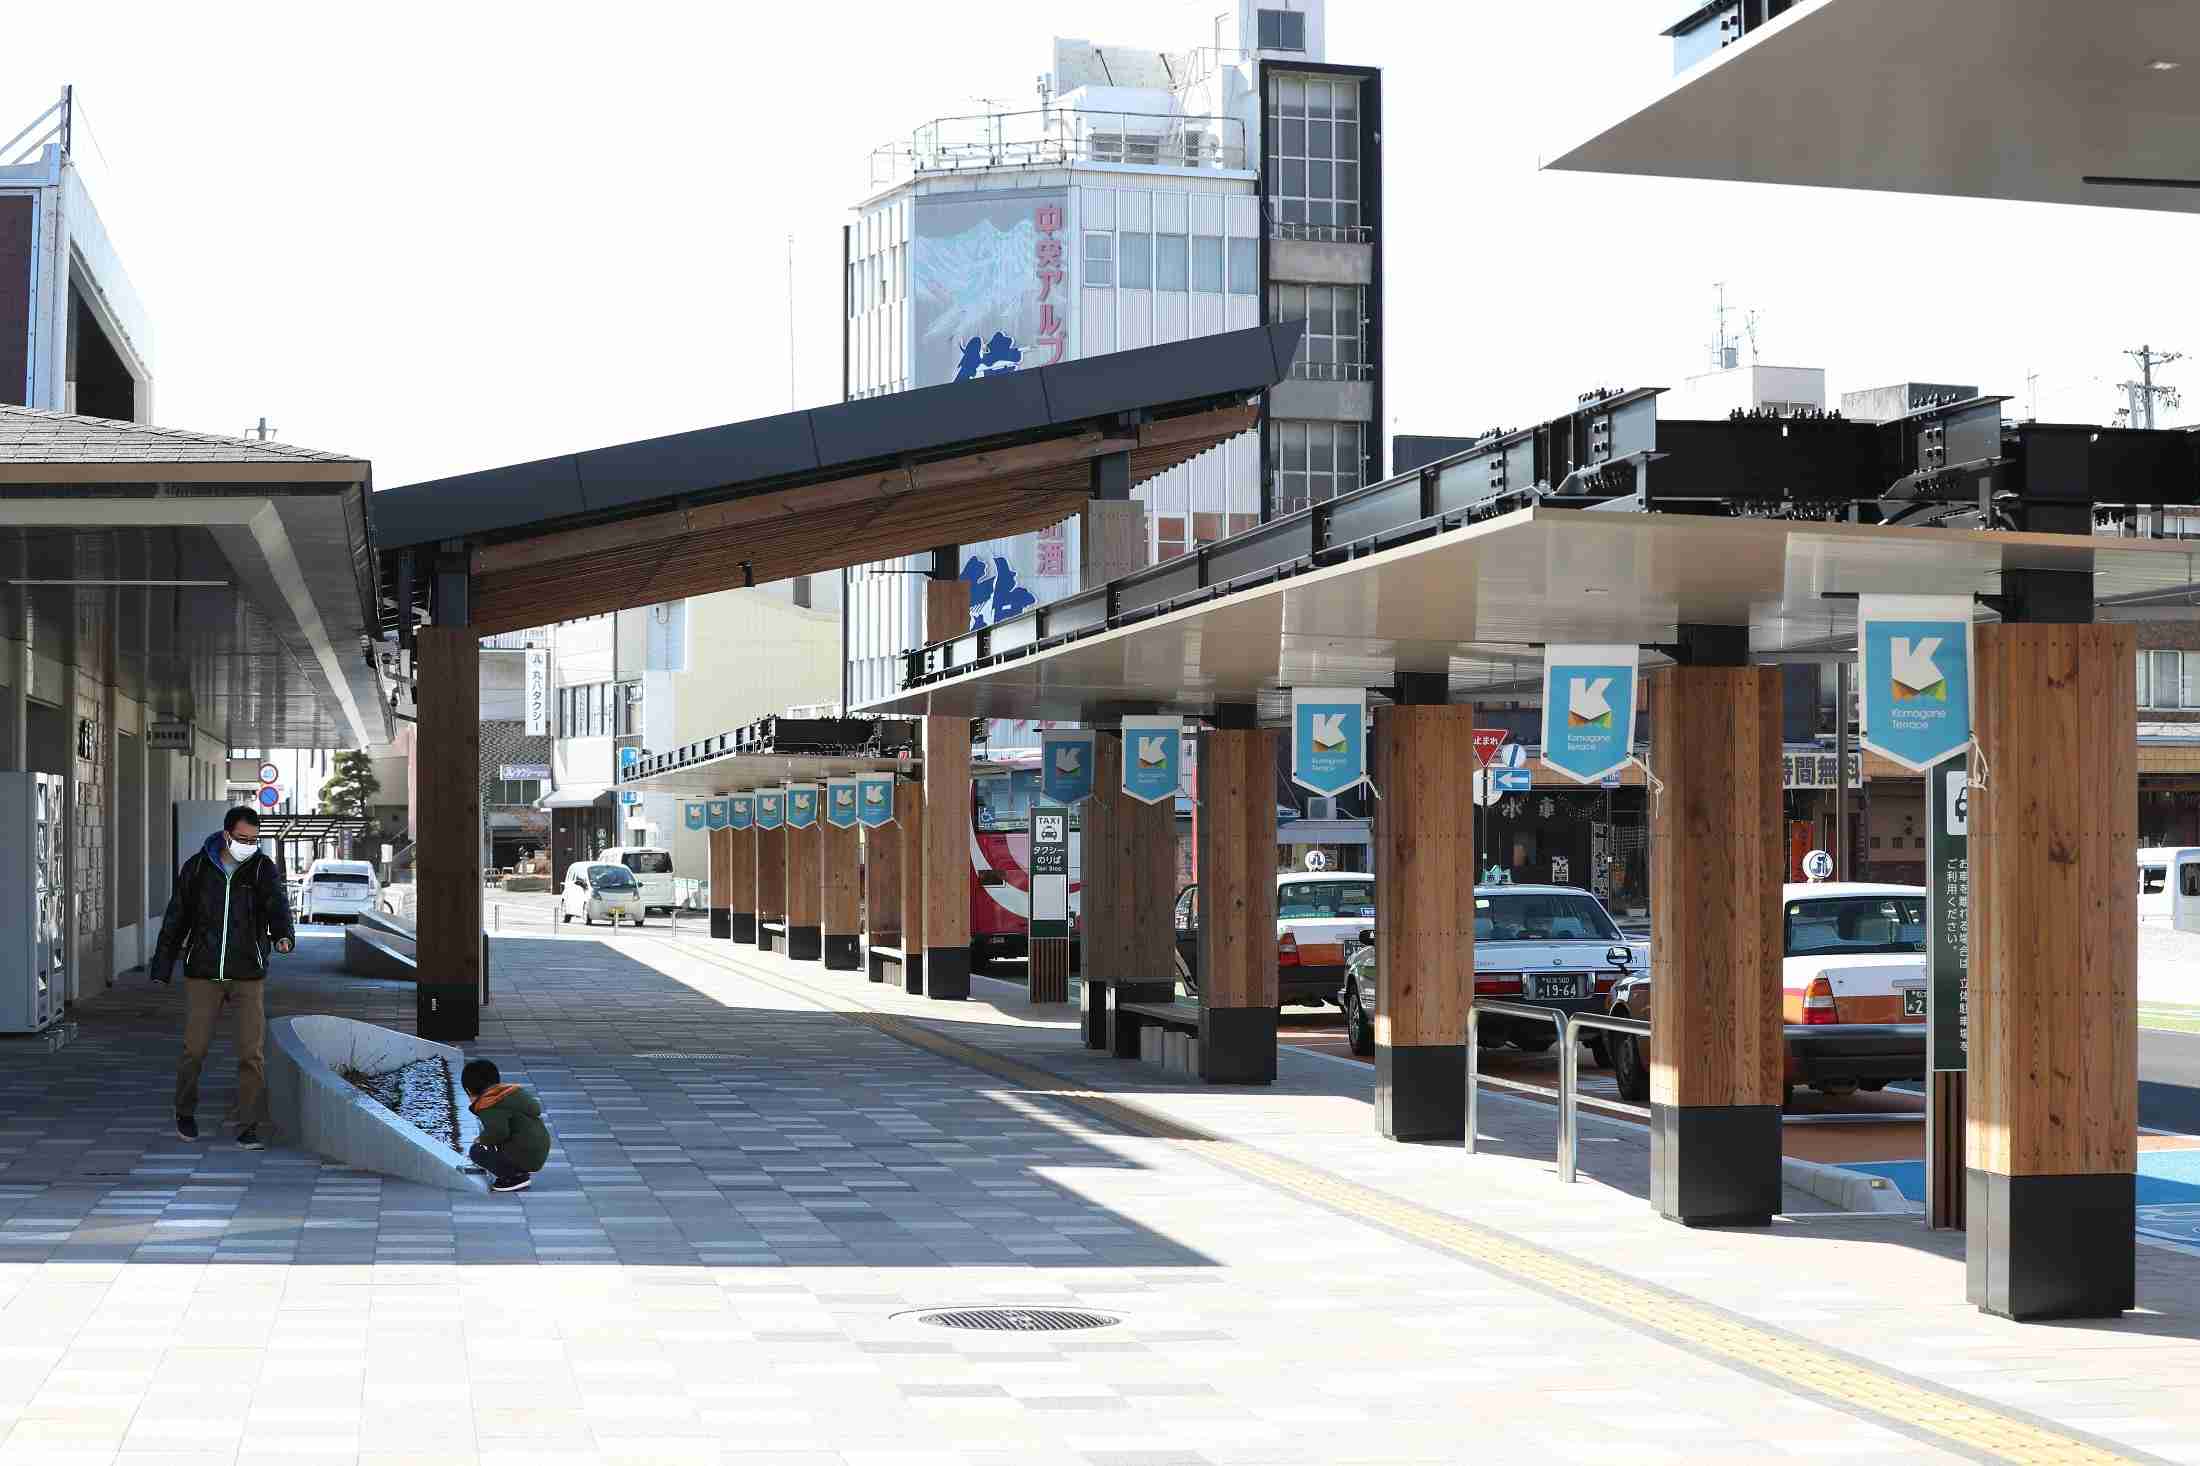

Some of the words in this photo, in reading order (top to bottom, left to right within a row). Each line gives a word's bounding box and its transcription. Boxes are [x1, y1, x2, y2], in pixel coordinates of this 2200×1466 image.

[1473, 735, 1499, 746] 止まれ
[1038, 816, 1061, 826] TAXI
[1033, 845, 1065, 856] タクシー
[1037, 855, 1062, 865] のりば
[1946, 858, 1958, 951] ご利用ください。
[1546, 983, 1577, 998] 19-64
